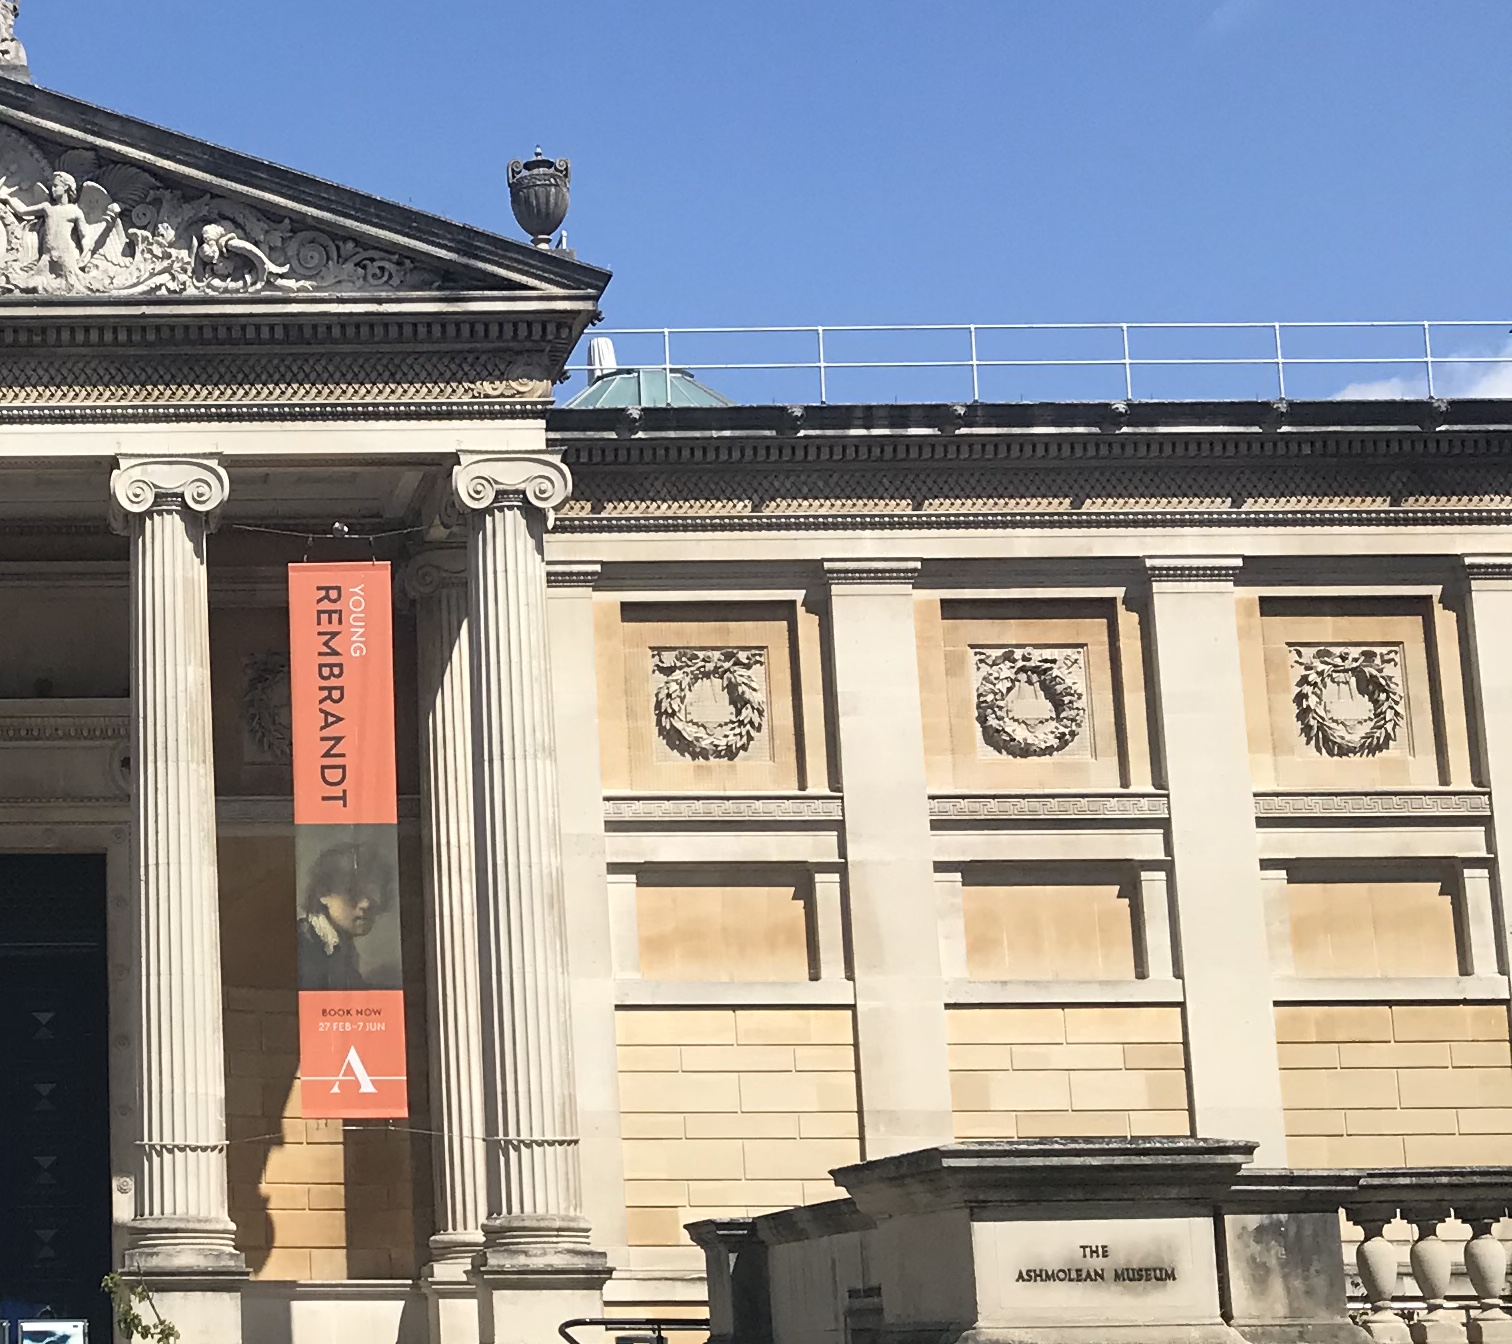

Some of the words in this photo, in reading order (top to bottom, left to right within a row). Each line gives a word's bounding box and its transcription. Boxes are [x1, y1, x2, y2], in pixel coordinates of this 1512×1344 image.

[349, 583, 367, 657] YOUNG
[316, 585, 347, 808] REMBRANDT
[322, 1008, 353, 1017] BOOK
[356, 1008, 382, 1016] NOW
[319, 1022, 330, 1032] 27
[366, 1022, 385, 1031] JUN
[330, 1045, 378, 1093] A
[1079, 1245, 1109, 1258] THE
[1016, 1268, 1105, 1282] ASHMOLEAN
[1114, 1267, 1176, 1282] MUSEUM
